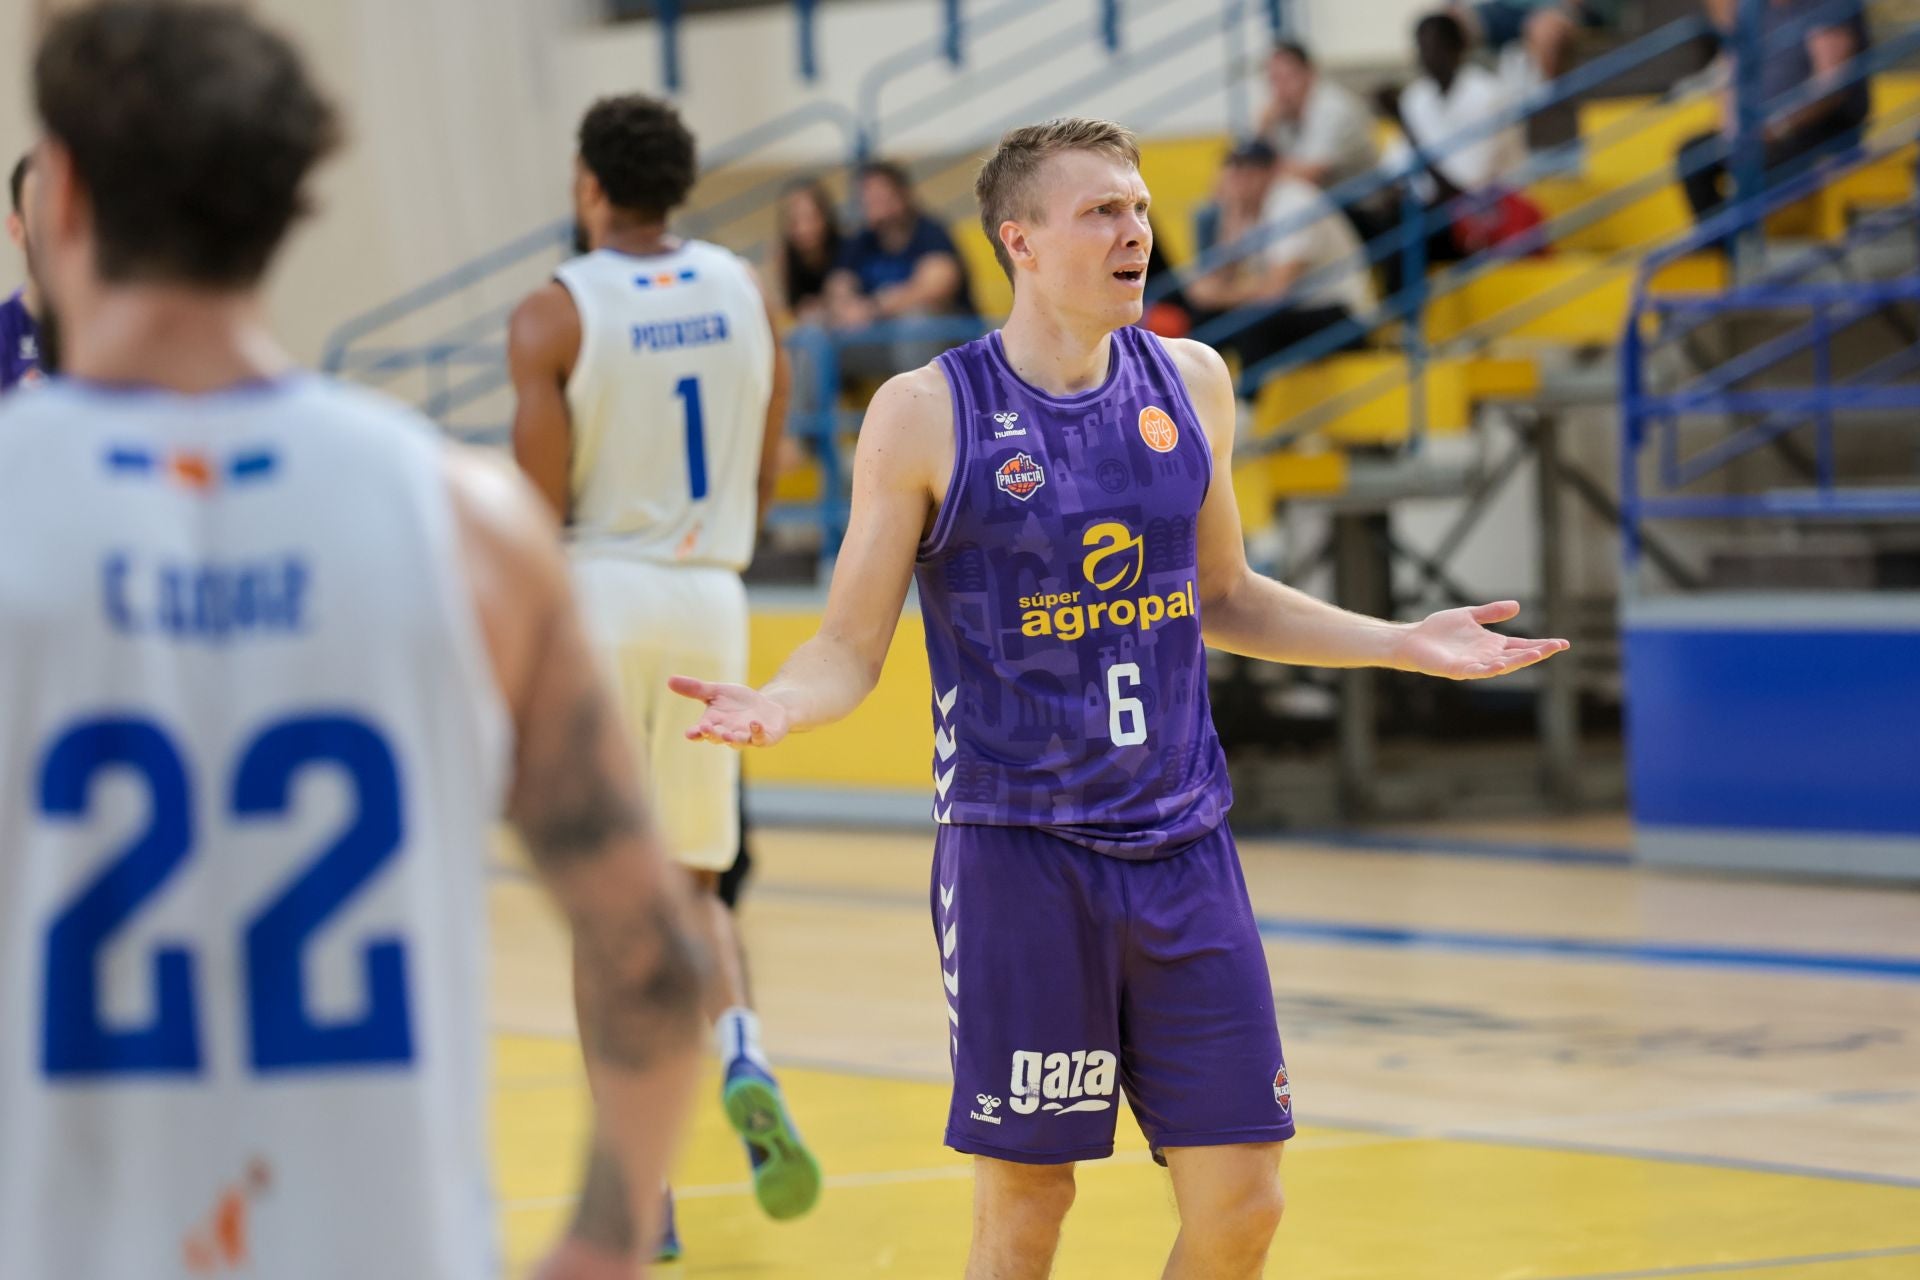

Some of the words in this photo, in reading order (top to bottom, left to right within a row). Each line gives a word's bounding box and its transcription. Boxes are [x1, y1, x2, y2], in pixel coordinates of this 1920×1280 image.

[675, 376, 709, 500] 1
[995, 428, 1027, 440] hummel
[998, 470, 1043, 487] PALENCIA
[1019, 590, 1081, 609] súper
[1020, 581, 1196, 641] agropal
[1107, 662, 1148, 747] 6
[36, 711, 417, 1081] 22
[1009, 1050, 1117, 1115] gaza
[970, 1109, 1002, 1125] hummel
